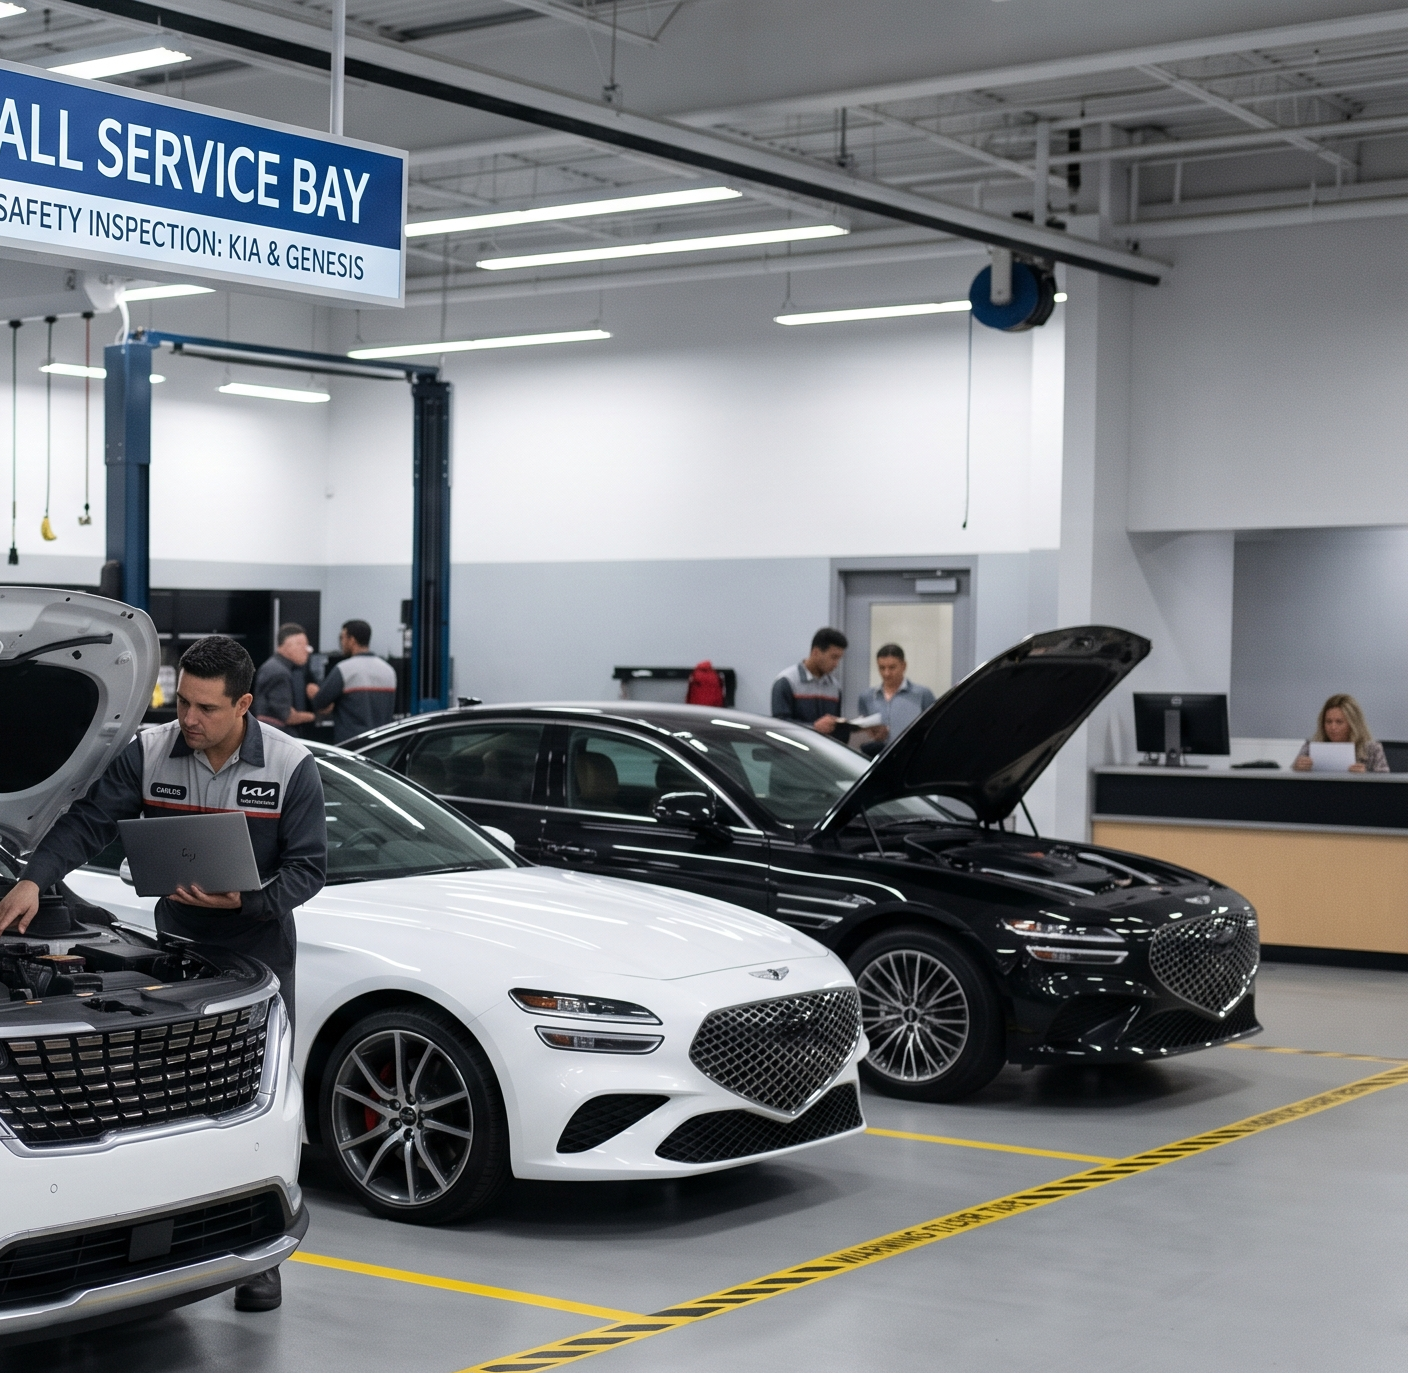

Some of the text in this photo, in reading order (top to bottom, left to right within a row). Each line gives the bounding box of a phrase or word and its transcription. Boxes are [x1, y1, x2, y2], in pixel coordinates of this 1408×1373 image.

[97, 117, 280, 209] SERVICE
[292, 159, 371, 225] BAY
[90, 210, 223, 259] INSPECTION:
[229, 236, 261, 264] KIA
[267, 241, 281, 268] &
[286, 244, 365, 281] GENESIS
